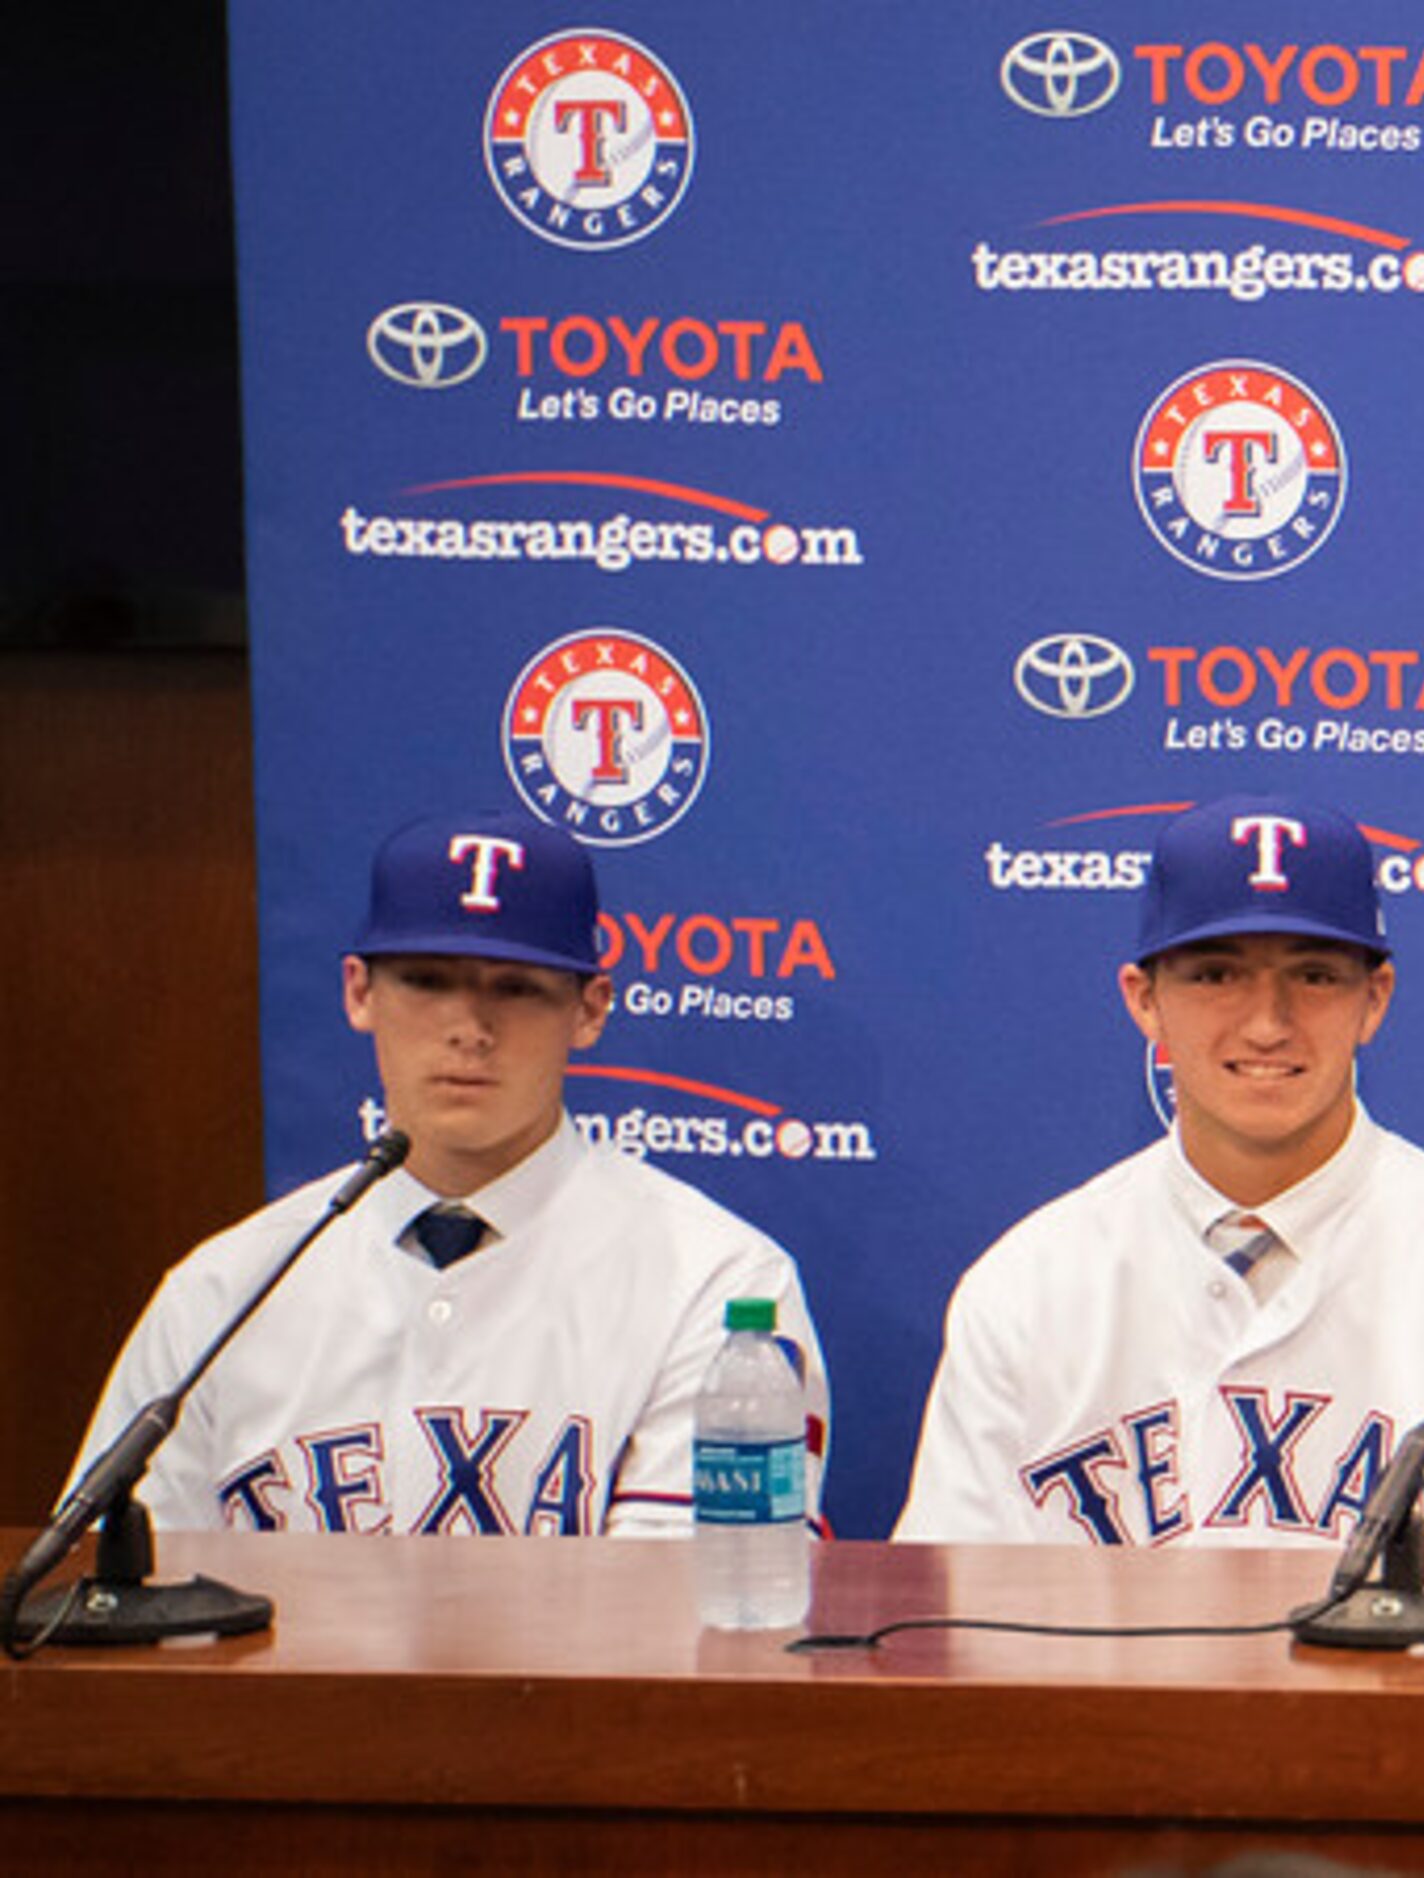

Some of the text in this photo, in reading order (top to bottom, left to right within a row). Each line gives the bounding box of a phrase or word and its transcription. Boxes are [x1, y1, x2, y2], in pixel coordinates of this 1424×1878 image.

[517, 46, 657, 96] TEXAS
[555, 100, 626, 187] T
[1150, 114, 1422, 151] Let's Go Places
[503, 155, 678, 235] RANGERS
[500, 315, 823, 382] TOYOTA
[518, 387, 781, 426] Let's Go Places
[1166, 375, 1311, 427] TEXAS
[1204, 432, 1279, 517] T
[341, 506, 864, 572] texasrangers.com
[1151, 485, 1331, 567] RANGERS
[535, 646, 674, 695] TEXAS
[572, 700, 643, 784] T
[1164, 717, 1248, 750] Let's
[1255, 717, 1307, 751] Go
[521, 752, 694, 833] RANGERS
[449, 834, 525, 914] T
[1230, 815, 1307, 892] T
[625, 983, 673, 1015] Go
[679, 984, 794, 1021] Places
[217, 1406, 597, 1537] TEXA
